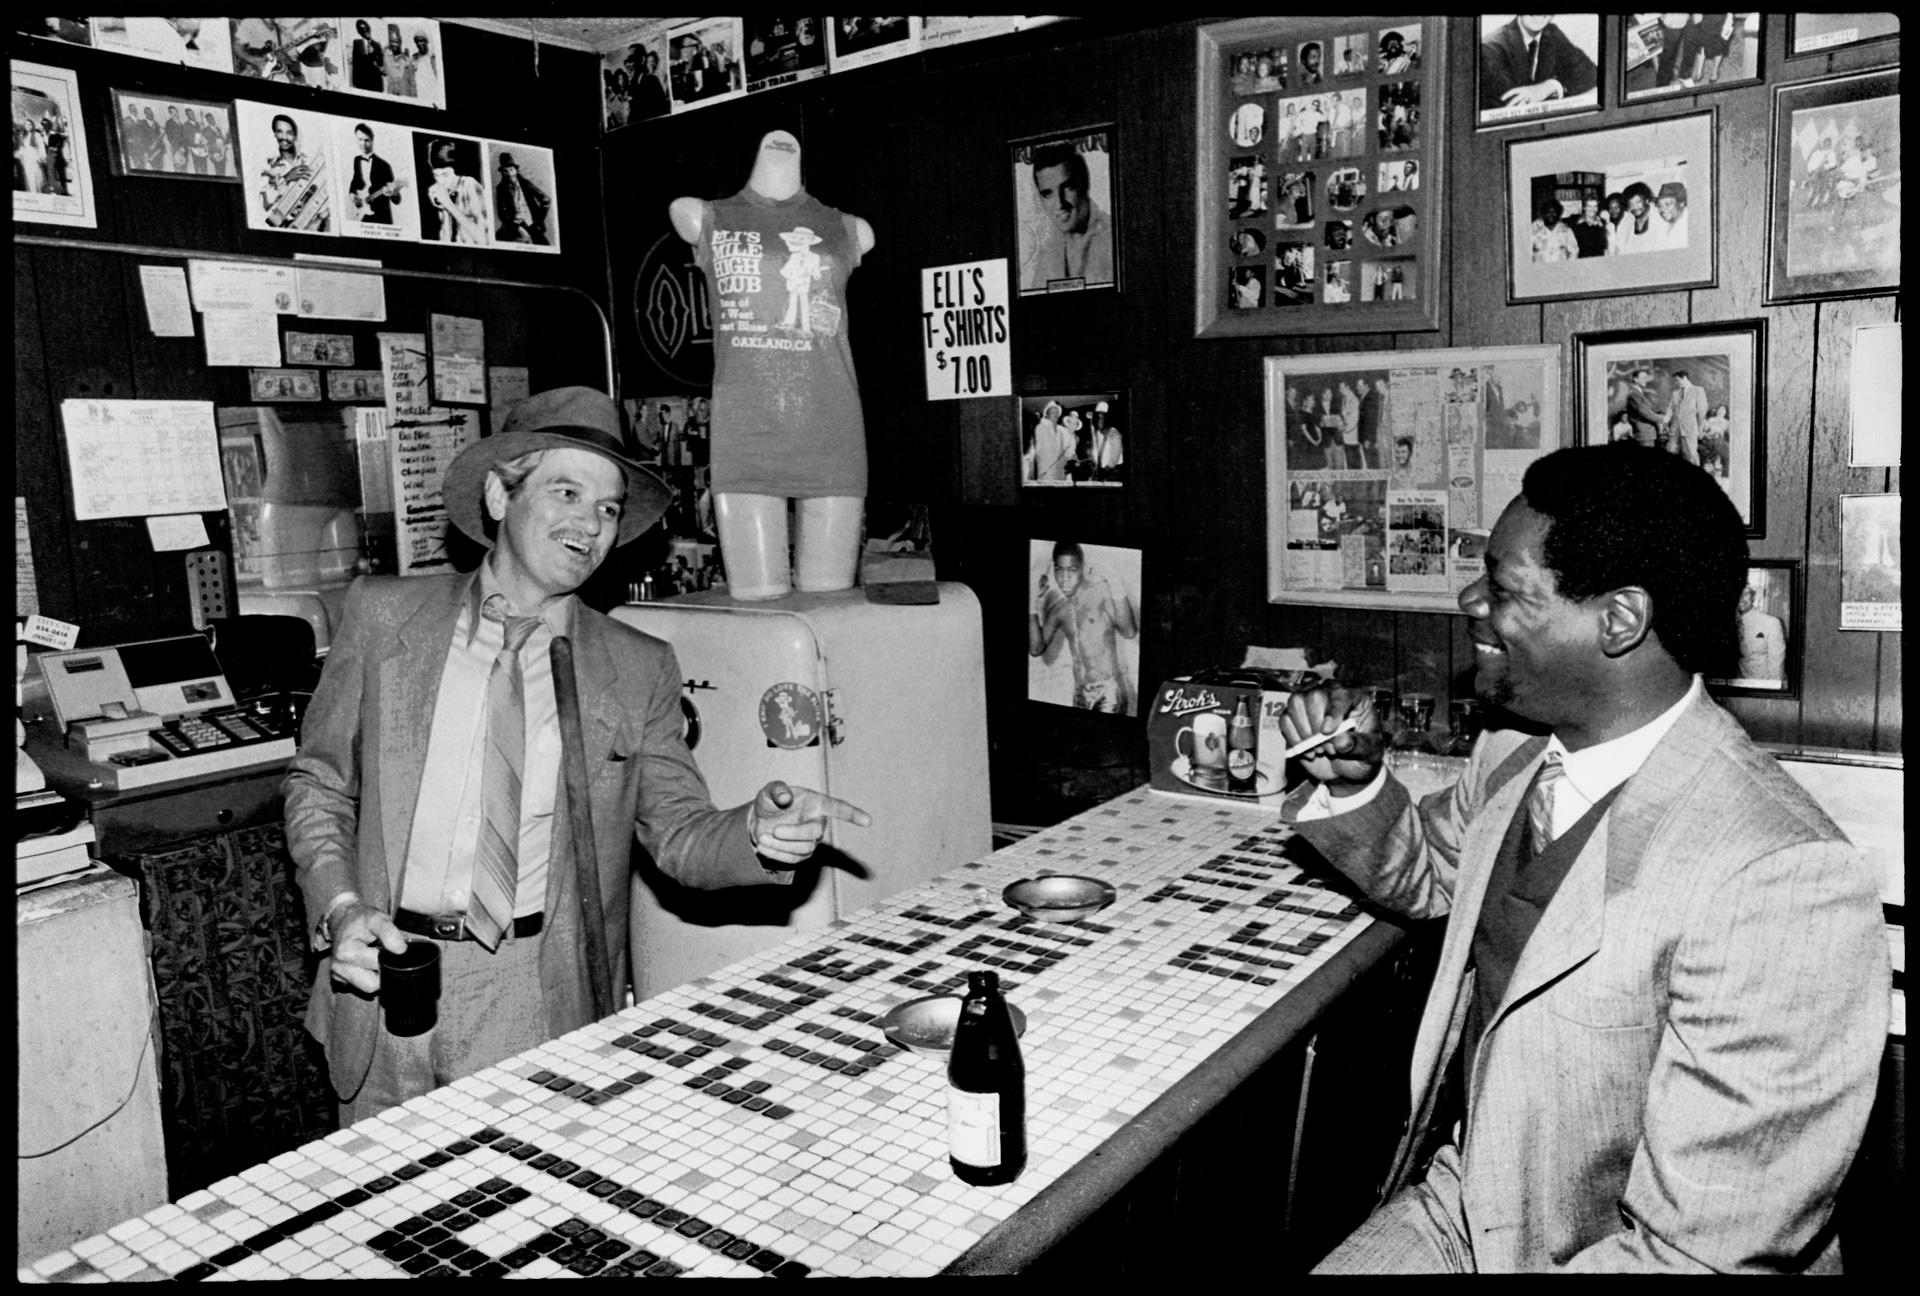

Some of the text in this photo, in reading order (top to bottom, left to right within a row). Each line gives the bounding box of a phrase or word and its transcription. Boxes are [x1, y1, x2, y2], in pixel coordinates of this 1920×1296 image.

[712, 243, 763, 262] MILE
[714, 257, 762, 278] HIGH
[718, 276, 762, 295] CLUB
[933, 267, 986, 309] ELI'S
[773, 683, 793, 693] LOVE
[1160, 688, 1217, 713] Stroh's
